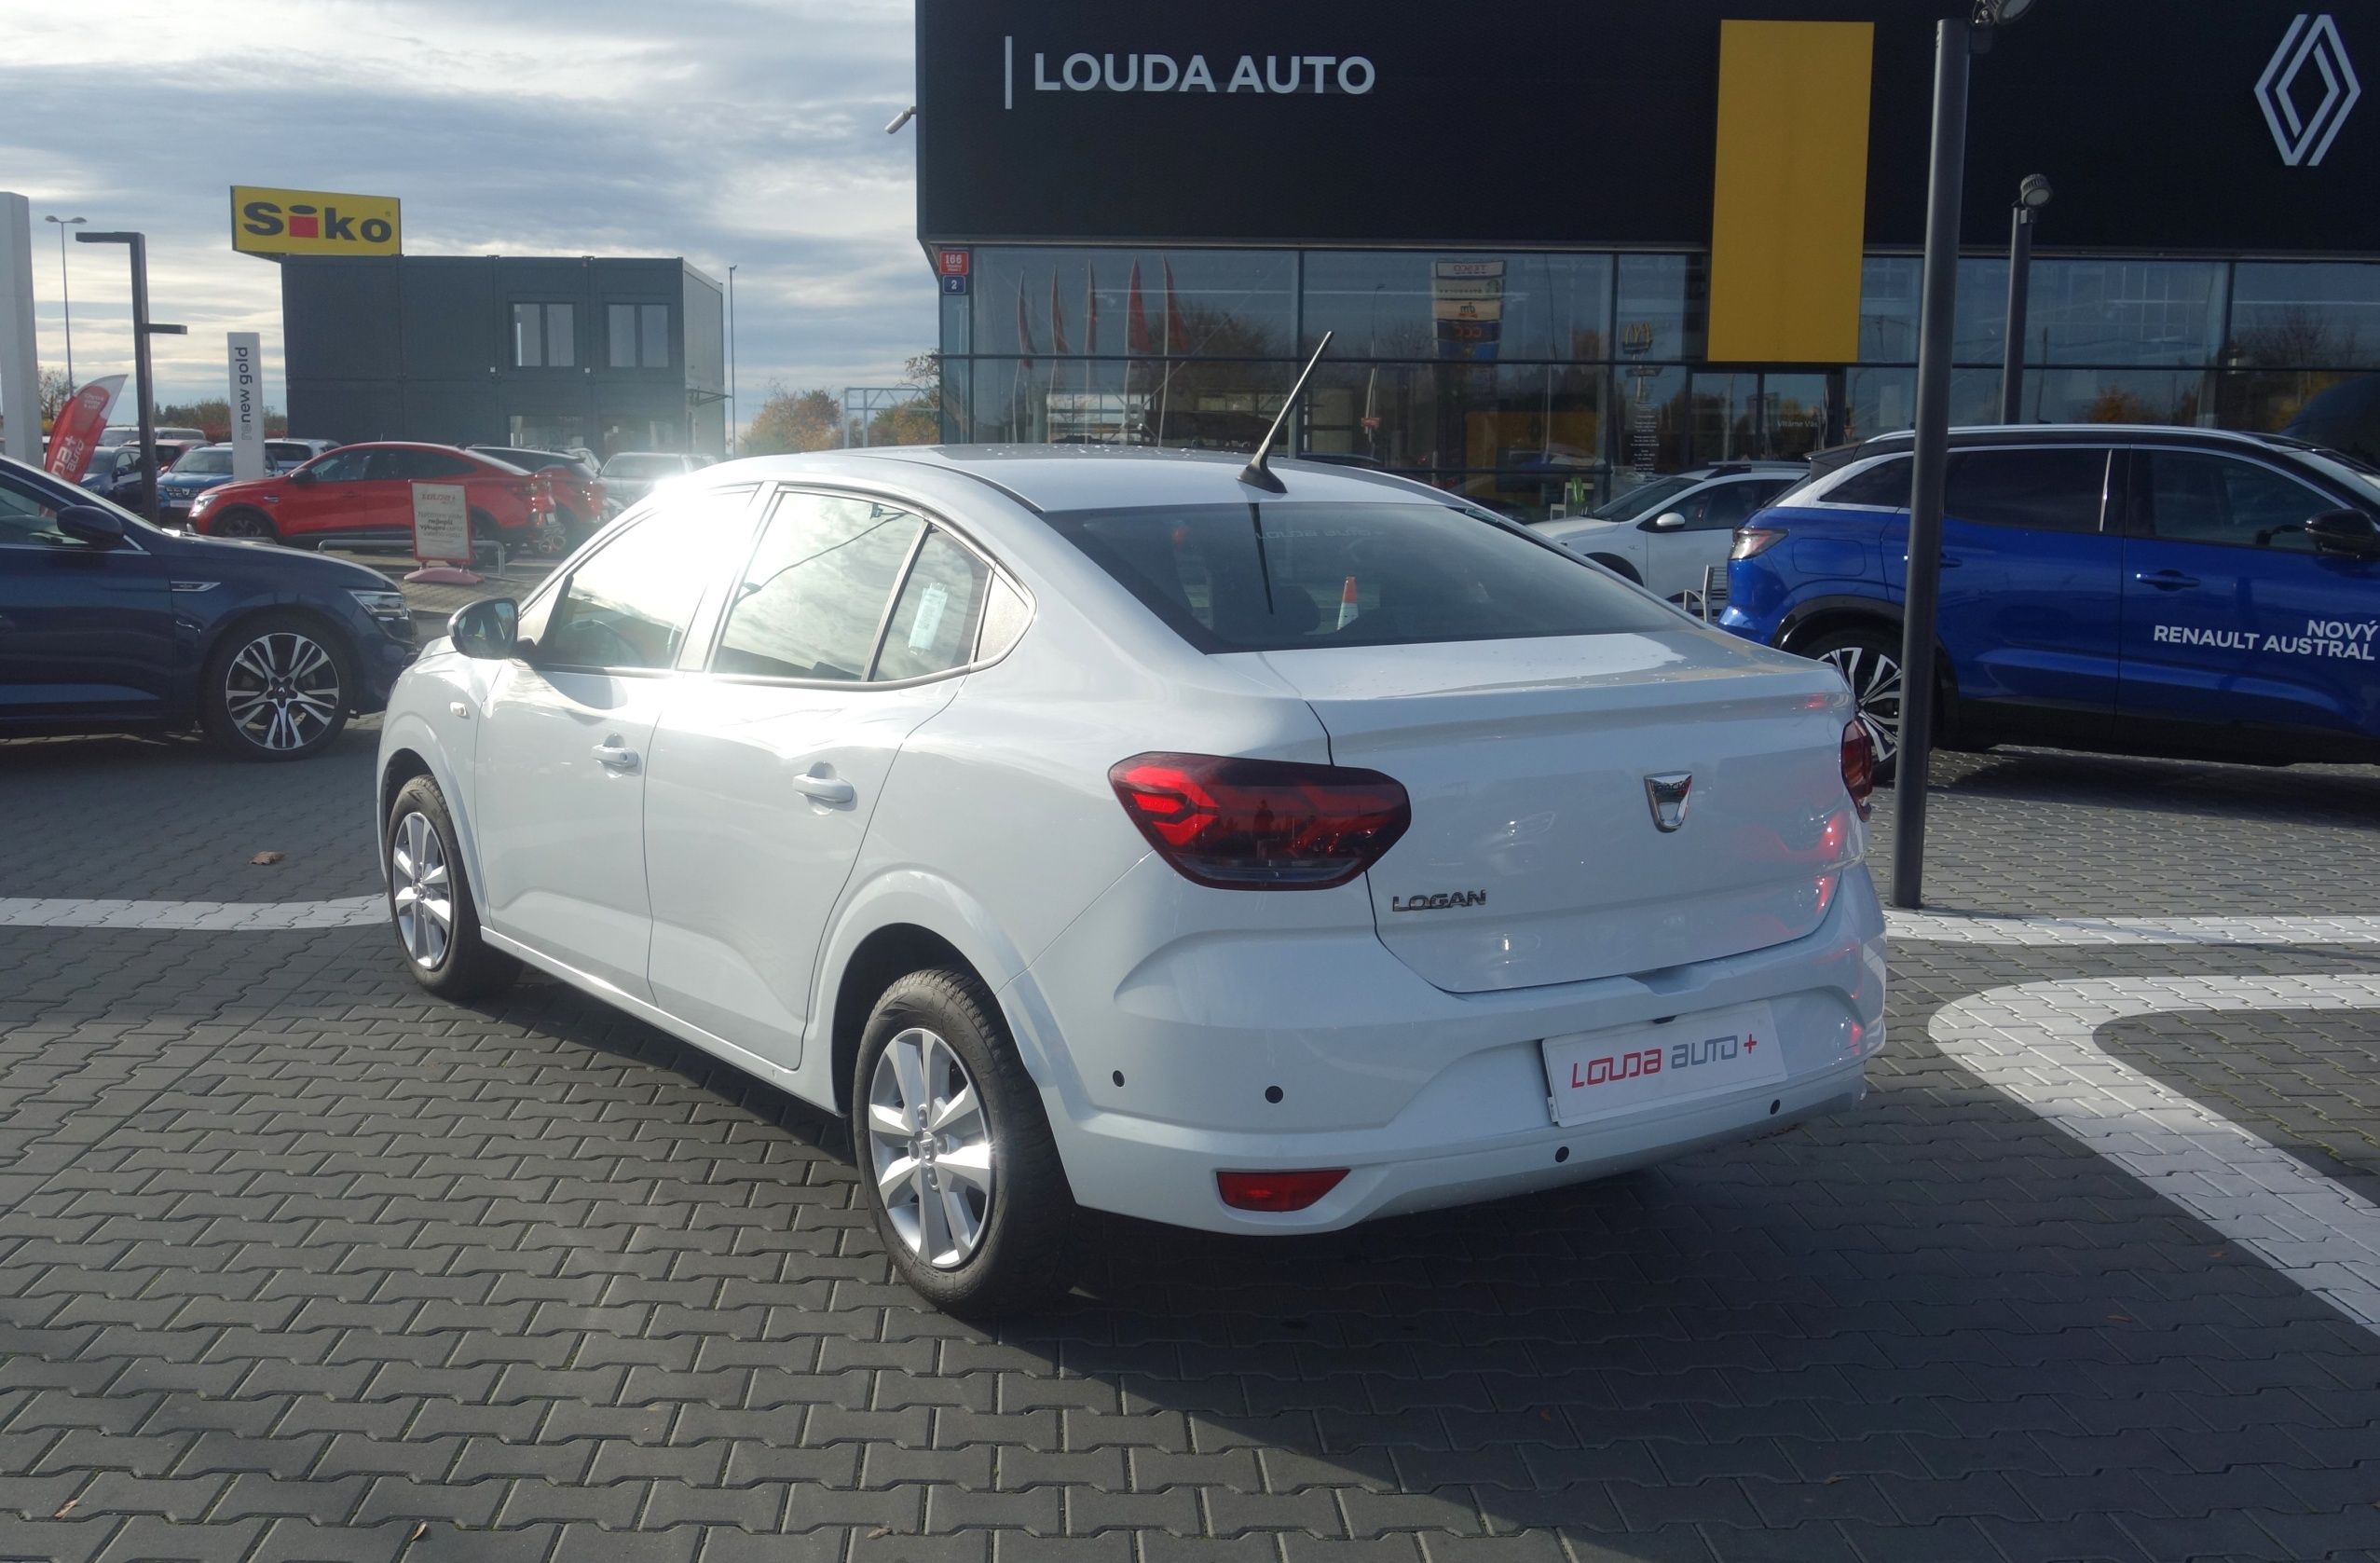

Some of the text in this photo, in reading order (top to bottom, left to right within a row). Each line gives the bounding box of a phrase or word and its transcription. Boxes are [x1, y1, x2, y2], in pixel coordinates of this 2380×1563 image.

[1034, 52, 1376, 94] LOUDA AUTO
[951, 280, 958, 290] 2
[234, 347, 253, 385] gold
[2154, 624, 2375, 661] RENAULT AUSTRAL
[2306, 620, 2379, 641] NOVÝ
[1392, 889, 1486, 912] LOGAN
